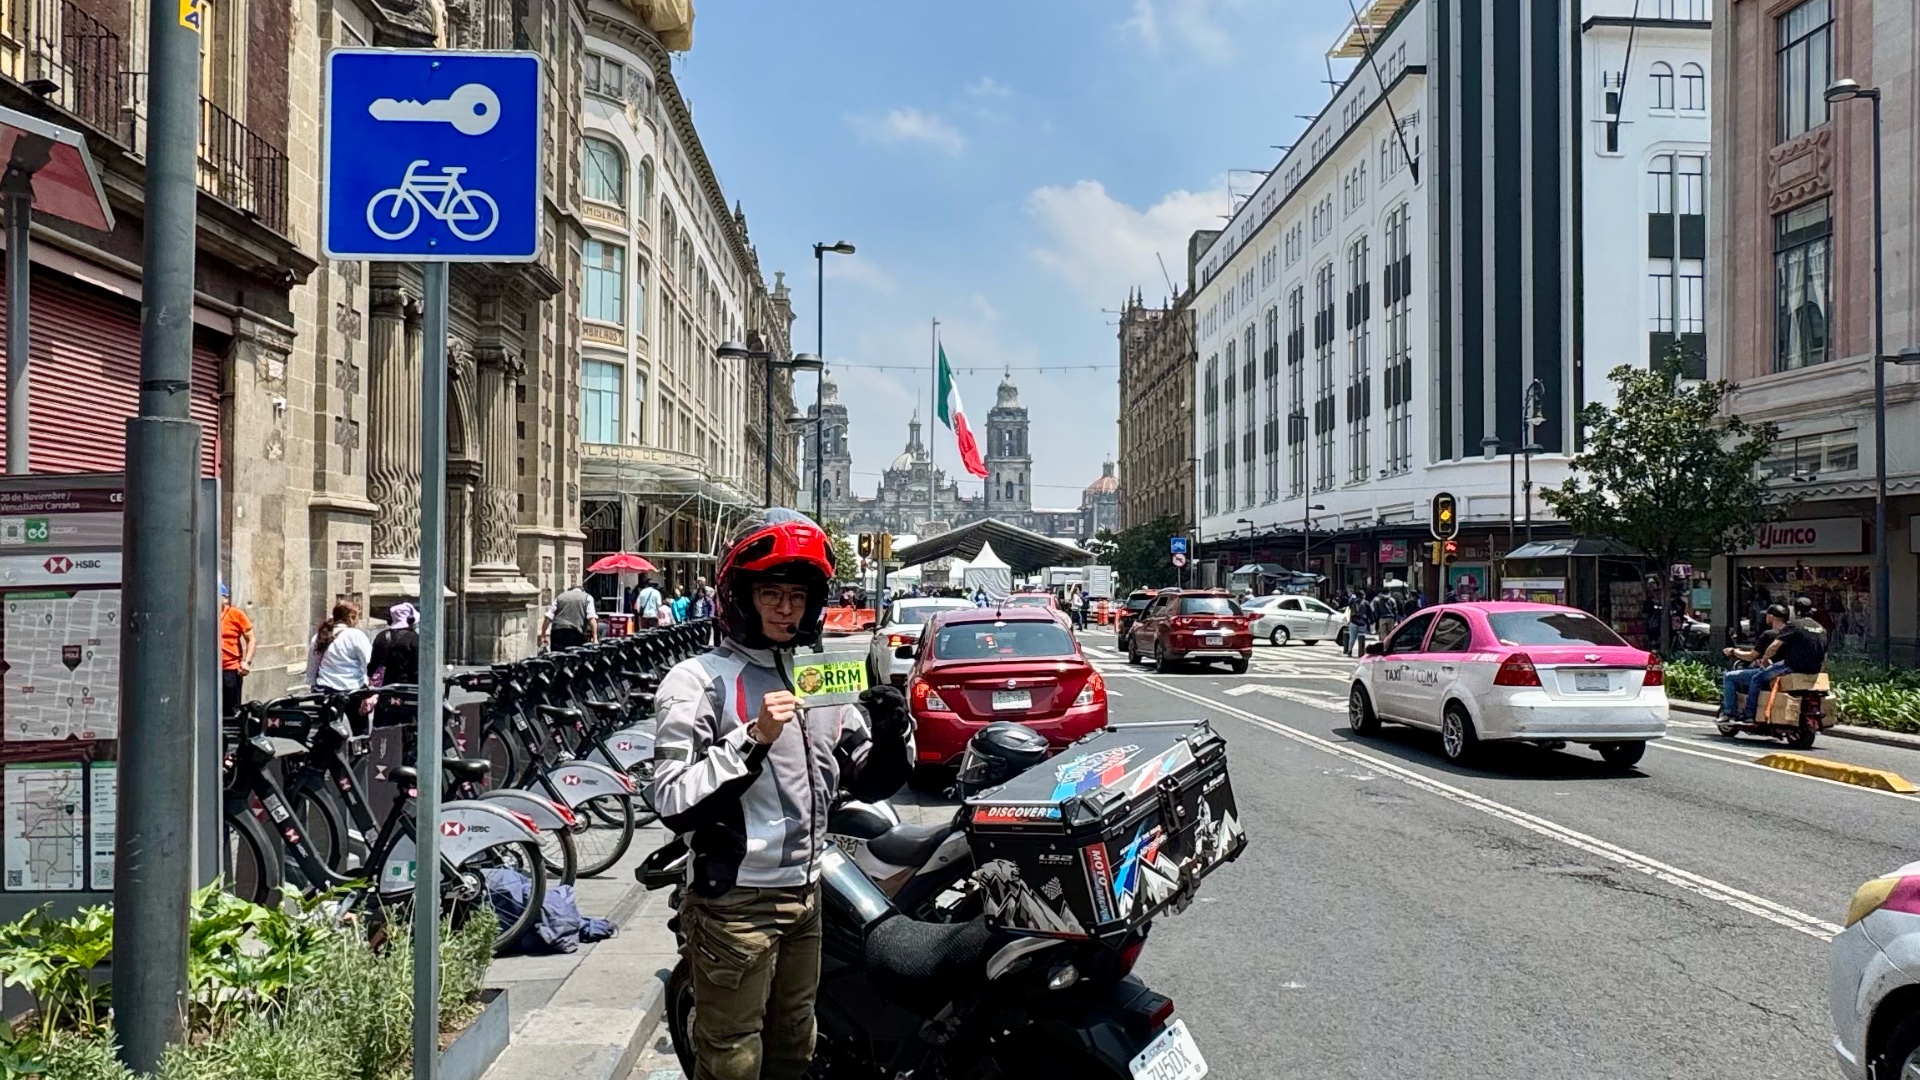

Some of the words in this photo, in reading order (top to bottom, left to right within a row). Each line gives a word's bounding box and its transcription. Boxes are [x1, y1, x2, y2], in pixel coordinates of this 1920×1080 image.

[642, 449, 659, 460] DE
[0, 493, 11, 501] 20
[11, 493, 21, 501] de
[23, 491, 66, 501] Noviembre
[0, 502, 44, 511] Venustiano
[45, 501, 80, 510] Carranza
[75, 560, 101, 569] HSBC
[824, 668, 862, 686] RRM
[1384, 669, 1401, 681] TAXI
[987, 807, 1056, 818] DISCOVERY
[467, 825, 490, 833] HSBC
[1091, 850, 1108, 887] MOTO
